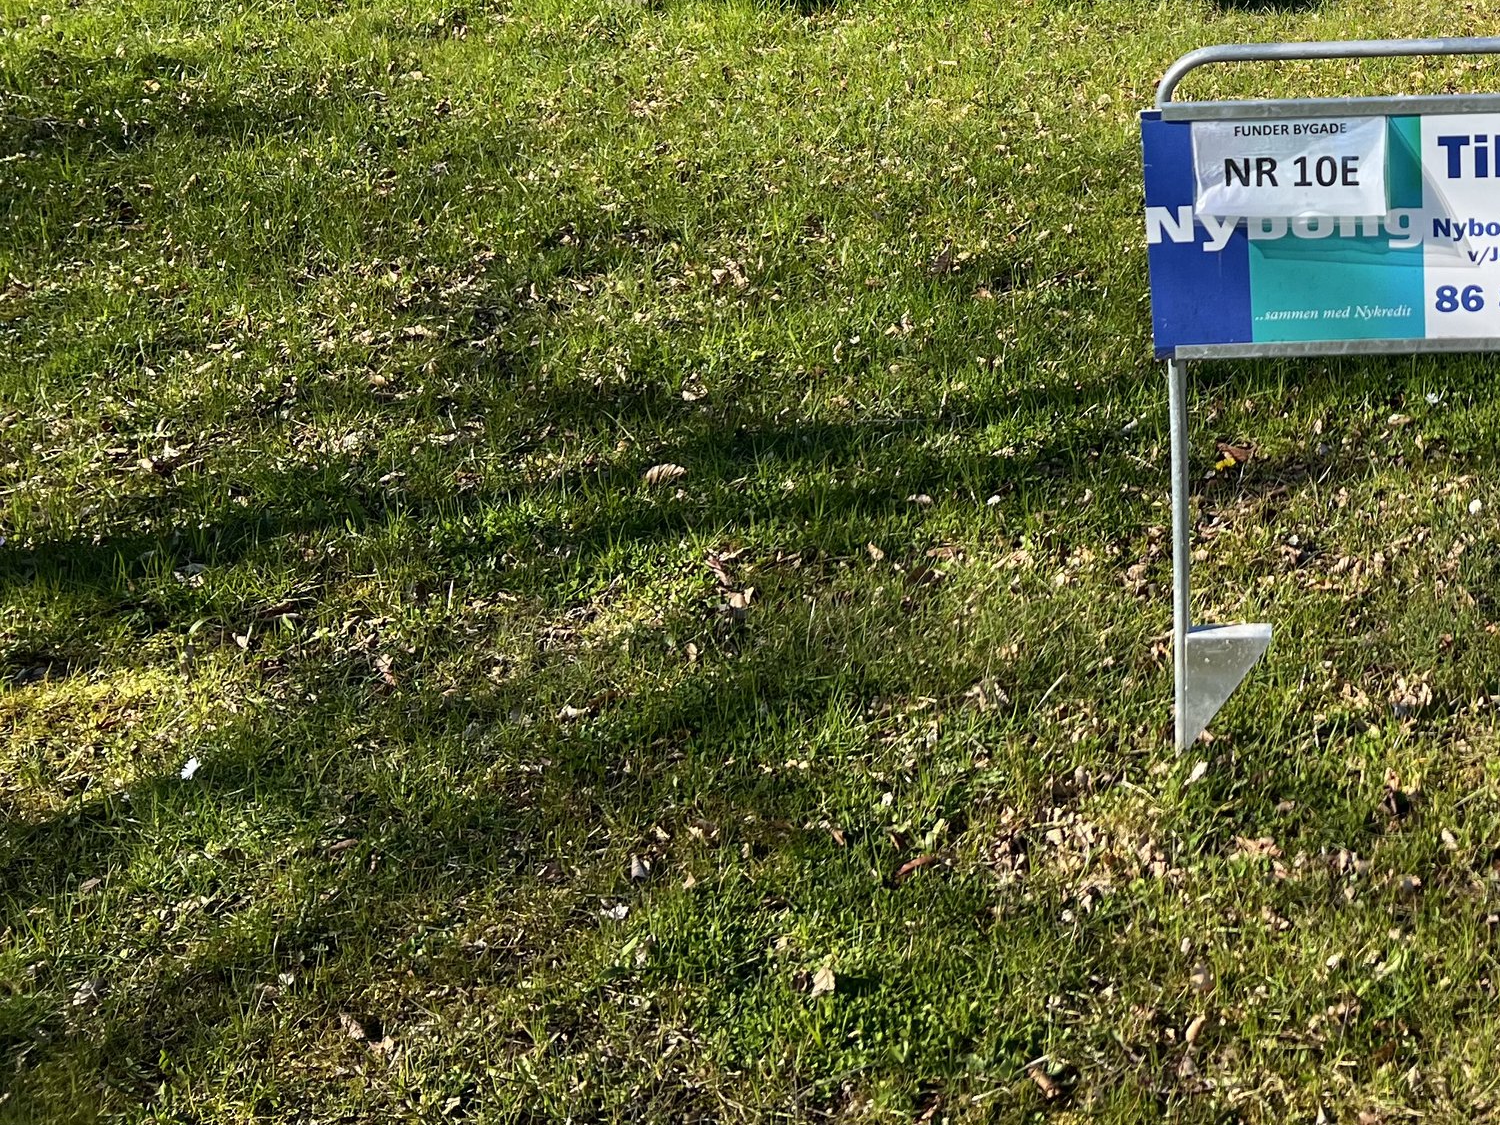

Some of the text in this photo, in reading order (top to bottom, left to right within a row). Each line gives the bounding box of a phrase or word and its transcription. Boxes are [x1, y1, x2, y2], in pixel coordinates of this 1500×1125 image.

[1234, 122, 1347, 137] FUNDER BYGADE
[1224, 155, 1360, 187] NR 10E
[1434, 284, 1485, 312] 86
[1323, 306, 1350, 318] med
[1354, 304, 1412, 322] Nykredit
